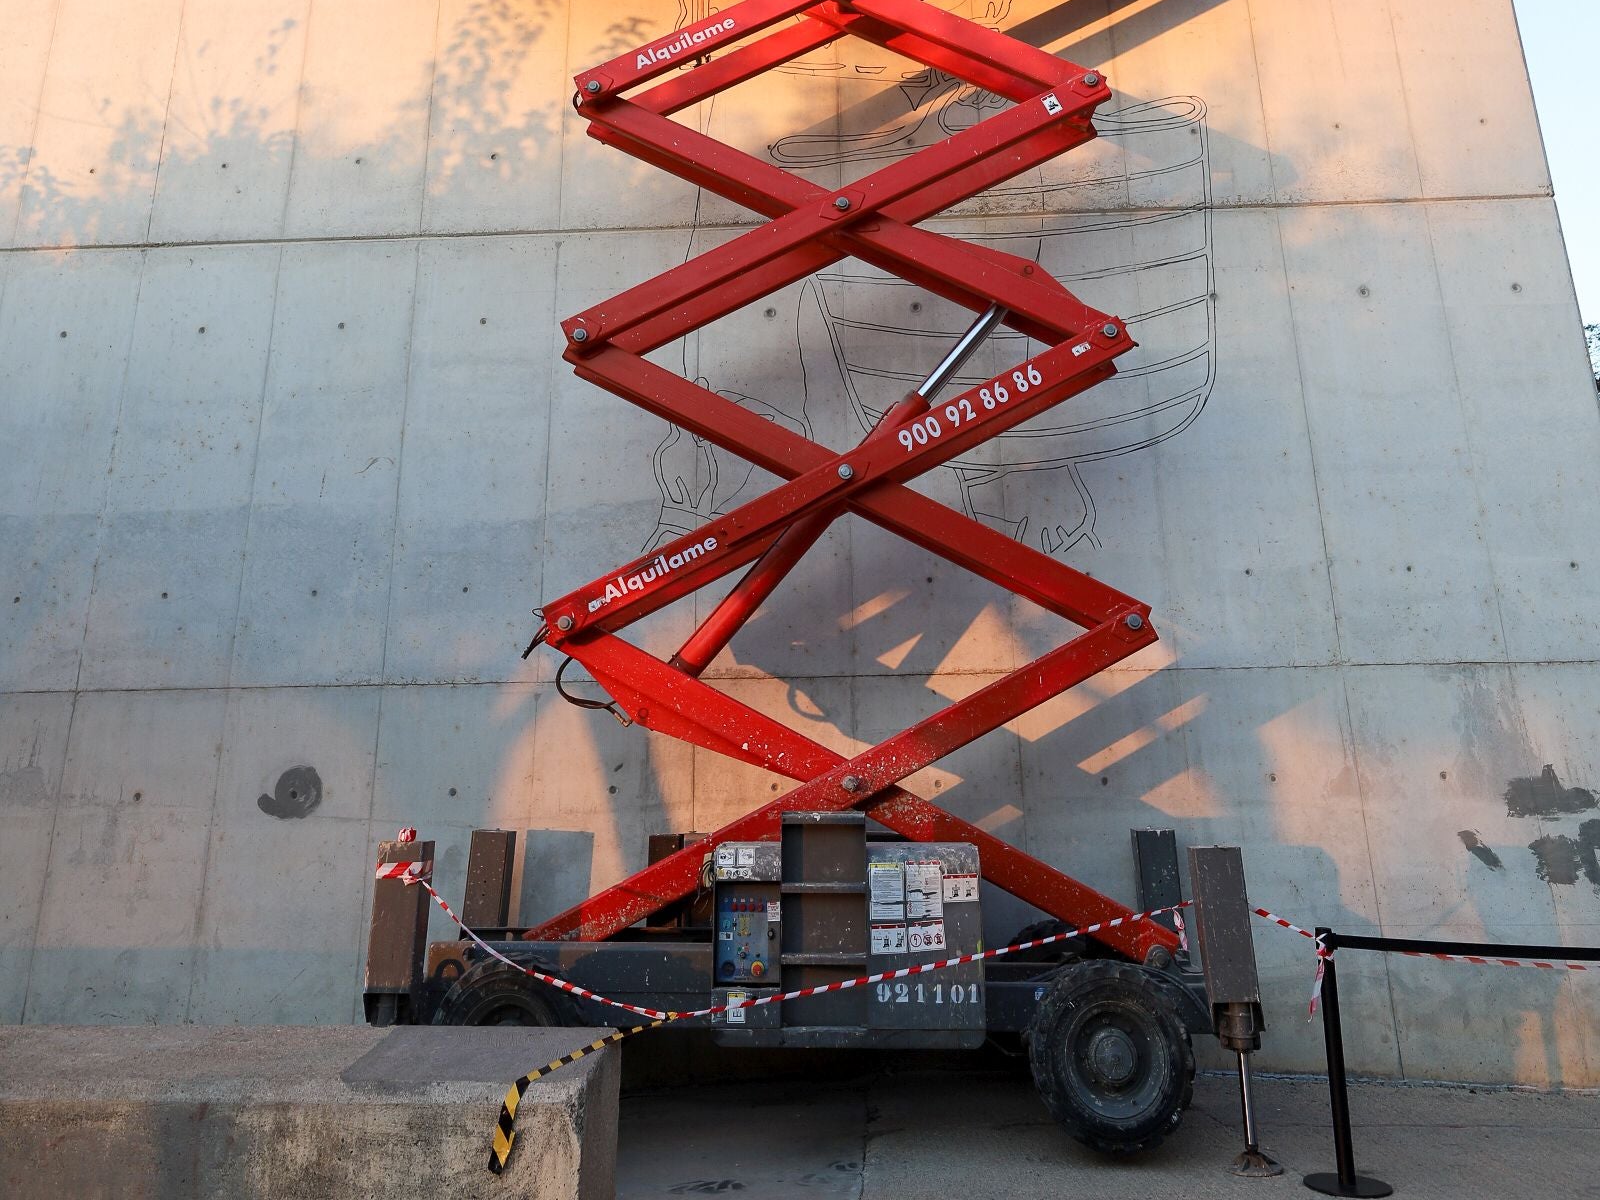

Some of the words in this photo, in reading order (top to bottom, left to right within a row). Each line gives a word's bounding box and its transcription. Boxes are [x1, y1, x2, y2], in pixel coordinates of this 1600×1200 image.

[898, 416, 941, 452] 900
[945, 399, 976, 428] 92
[979, 381, 1009, 410] 86
[1012, 364, 1042, 393] 86
[605, 537, 718, 603] Alquílame
[876, 983, 979, 1004] 921101
